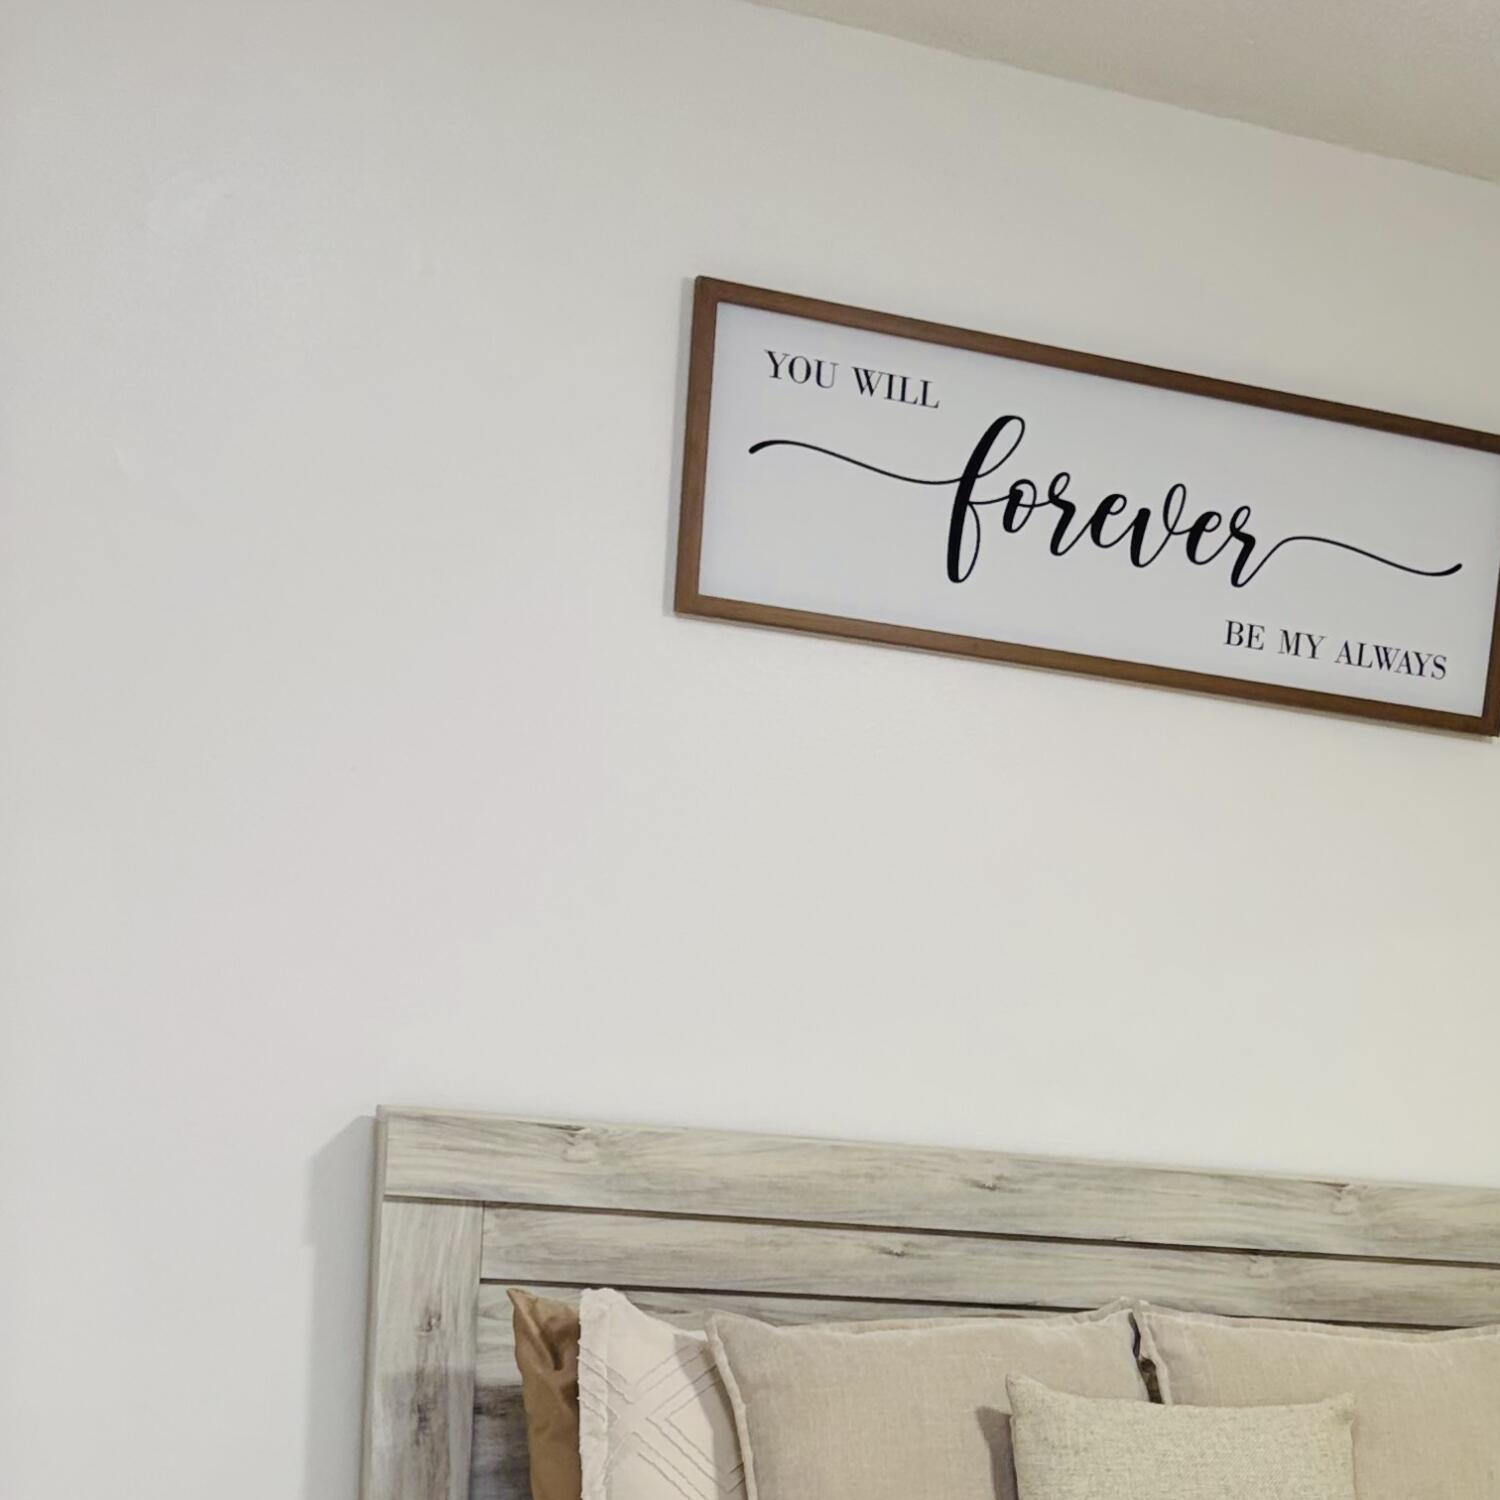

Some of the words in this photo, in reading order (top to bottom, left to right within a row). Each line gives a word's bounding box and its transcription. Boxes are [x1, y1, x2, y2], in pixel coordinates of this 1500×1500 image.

[765, 348, 839, 389] YOU
[851, 365, 941, 410] WILL
[748, 414, 1463, 588] forever
[1224, 619, 1266, 652] BE
[1279, 628, 1327, 661] MY
[1333, 641, 1449, 681] ALWAYS
